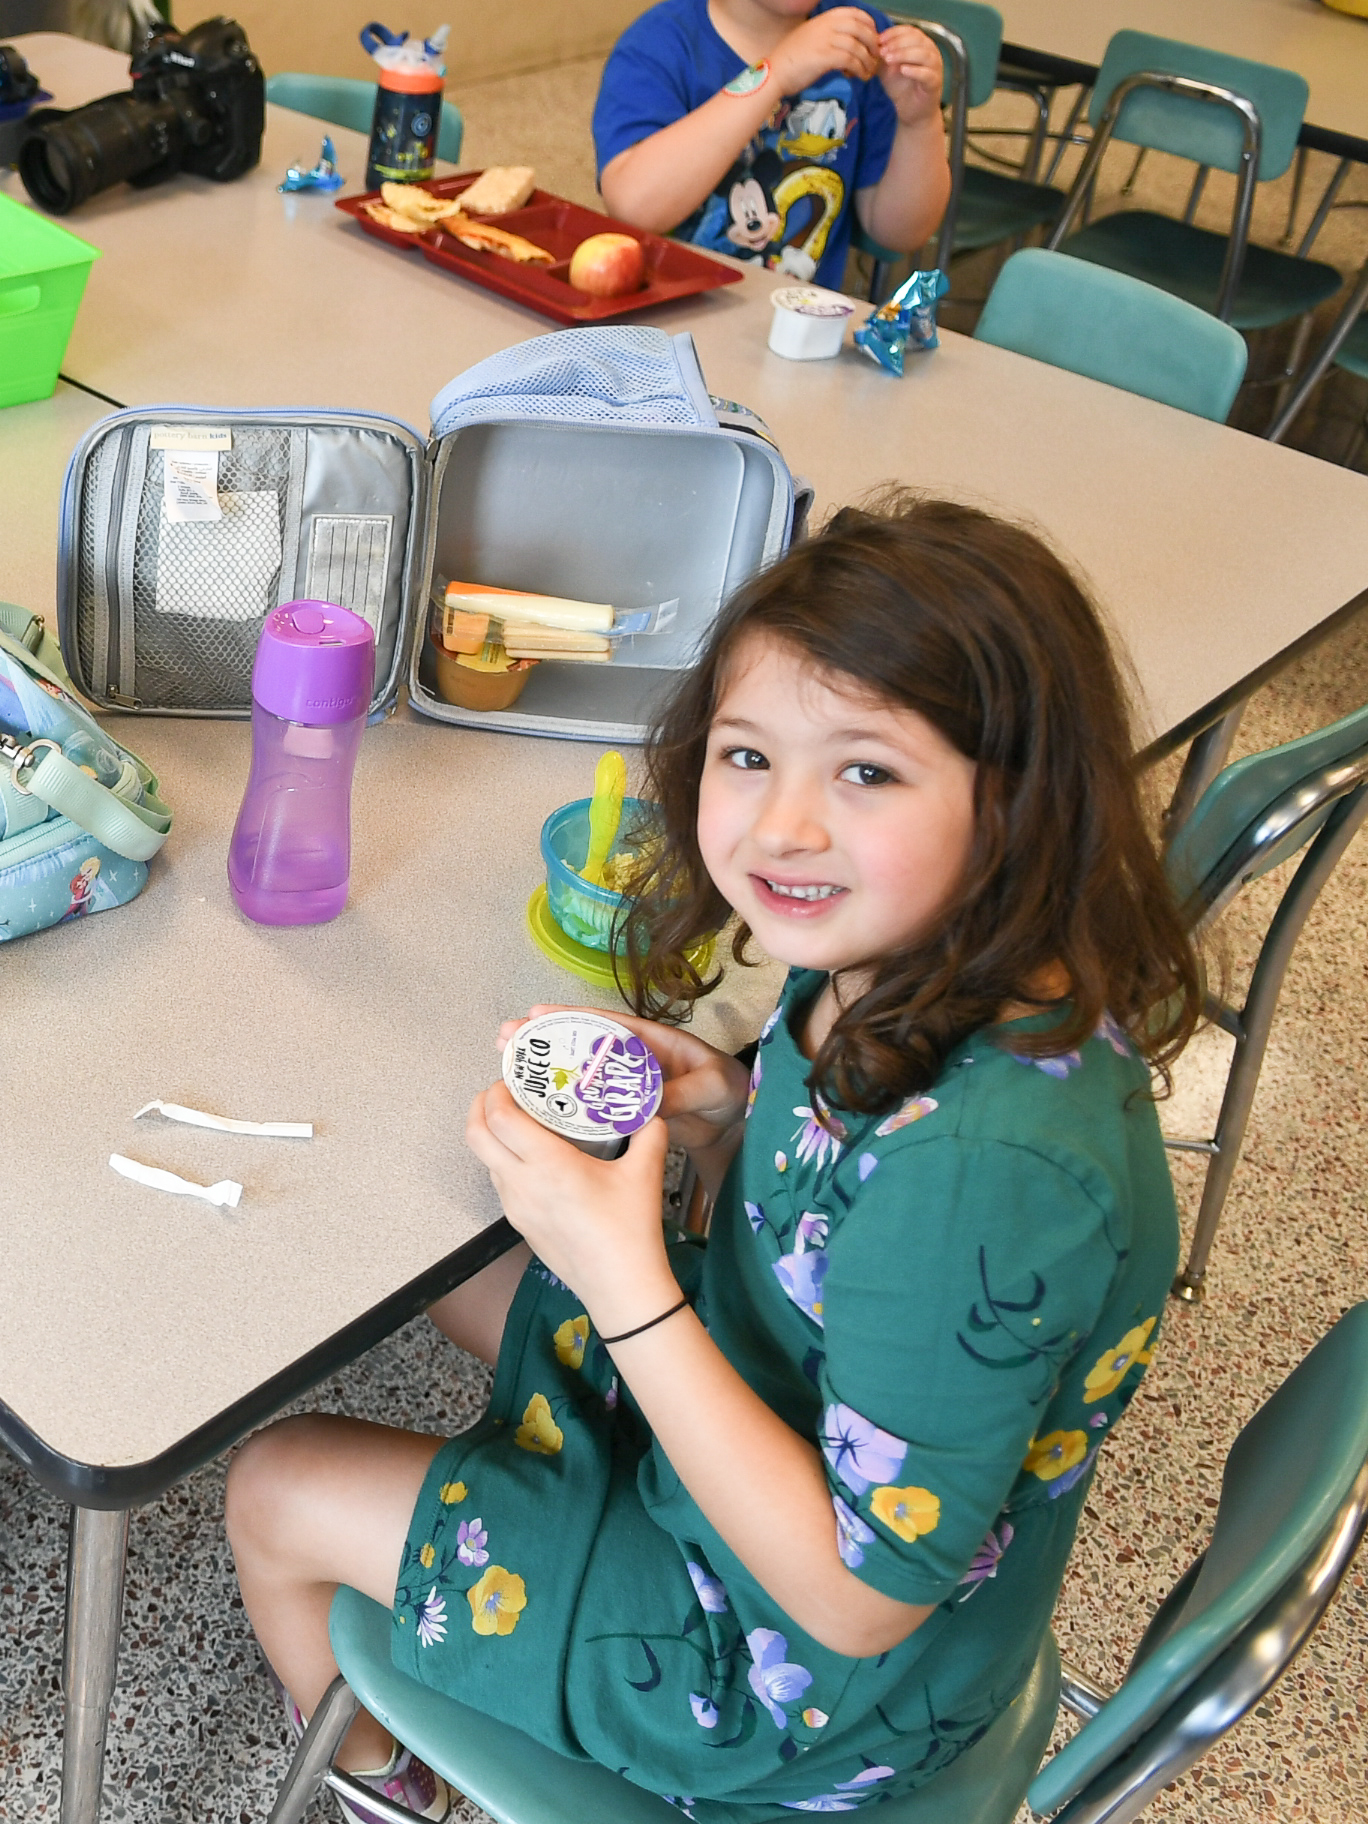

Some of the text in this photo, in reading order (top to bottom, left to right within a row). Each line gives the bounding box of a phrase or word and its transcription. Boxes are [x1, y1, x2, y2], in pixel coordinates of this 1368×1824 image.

[153, 431, 185, 441] pottery
[188, 432, 208, 440] barn
[306, 698, 352, 709] contigo
[514, 1047, 527, 1080] NEW YORK
[523, 1038, 551, 1098] JUICE CO.
[597, 1044, 645, 1121] GRAPE
